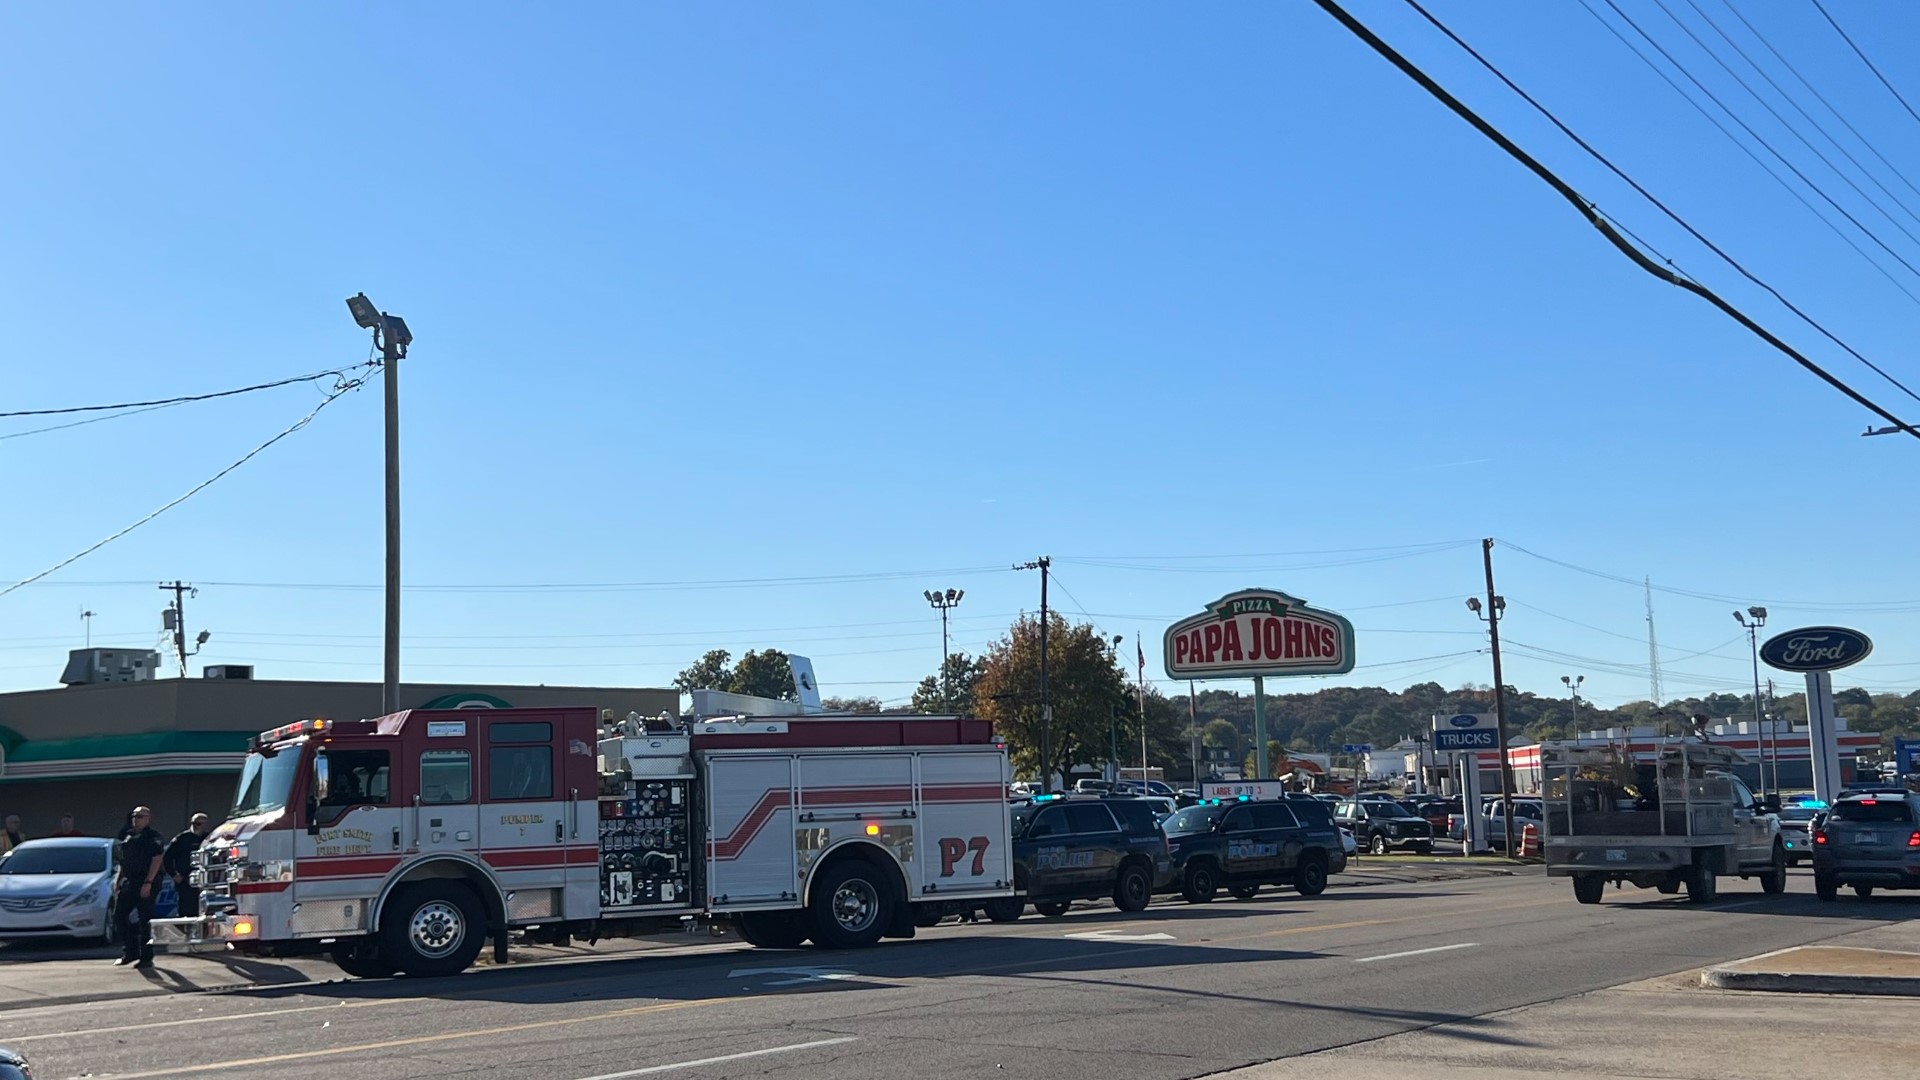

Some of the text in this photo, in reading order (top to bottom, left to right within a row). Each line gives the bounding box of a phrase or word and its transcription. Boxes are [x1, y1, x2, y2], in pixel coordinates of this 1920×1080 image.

[1233, 600, 1272, 612] PIZZA
[1175, 618, 1336, 664] PAPA JOHNS
[1782, 636, 1846, 663] Ford
[1441, 733, 1492, 745] TRUCKS
[1212, 787, 1231, 795] LARGE
[1234, 786, 1242, 795] UP
[1245, 786, 1253, 794] TO
[501, 814, 544, 825] PUMPER
[314, 829, 373, 844] FORT SMITH
[316, 846, 340, 856] FIRE
[939, 836, 990, 877] P7
